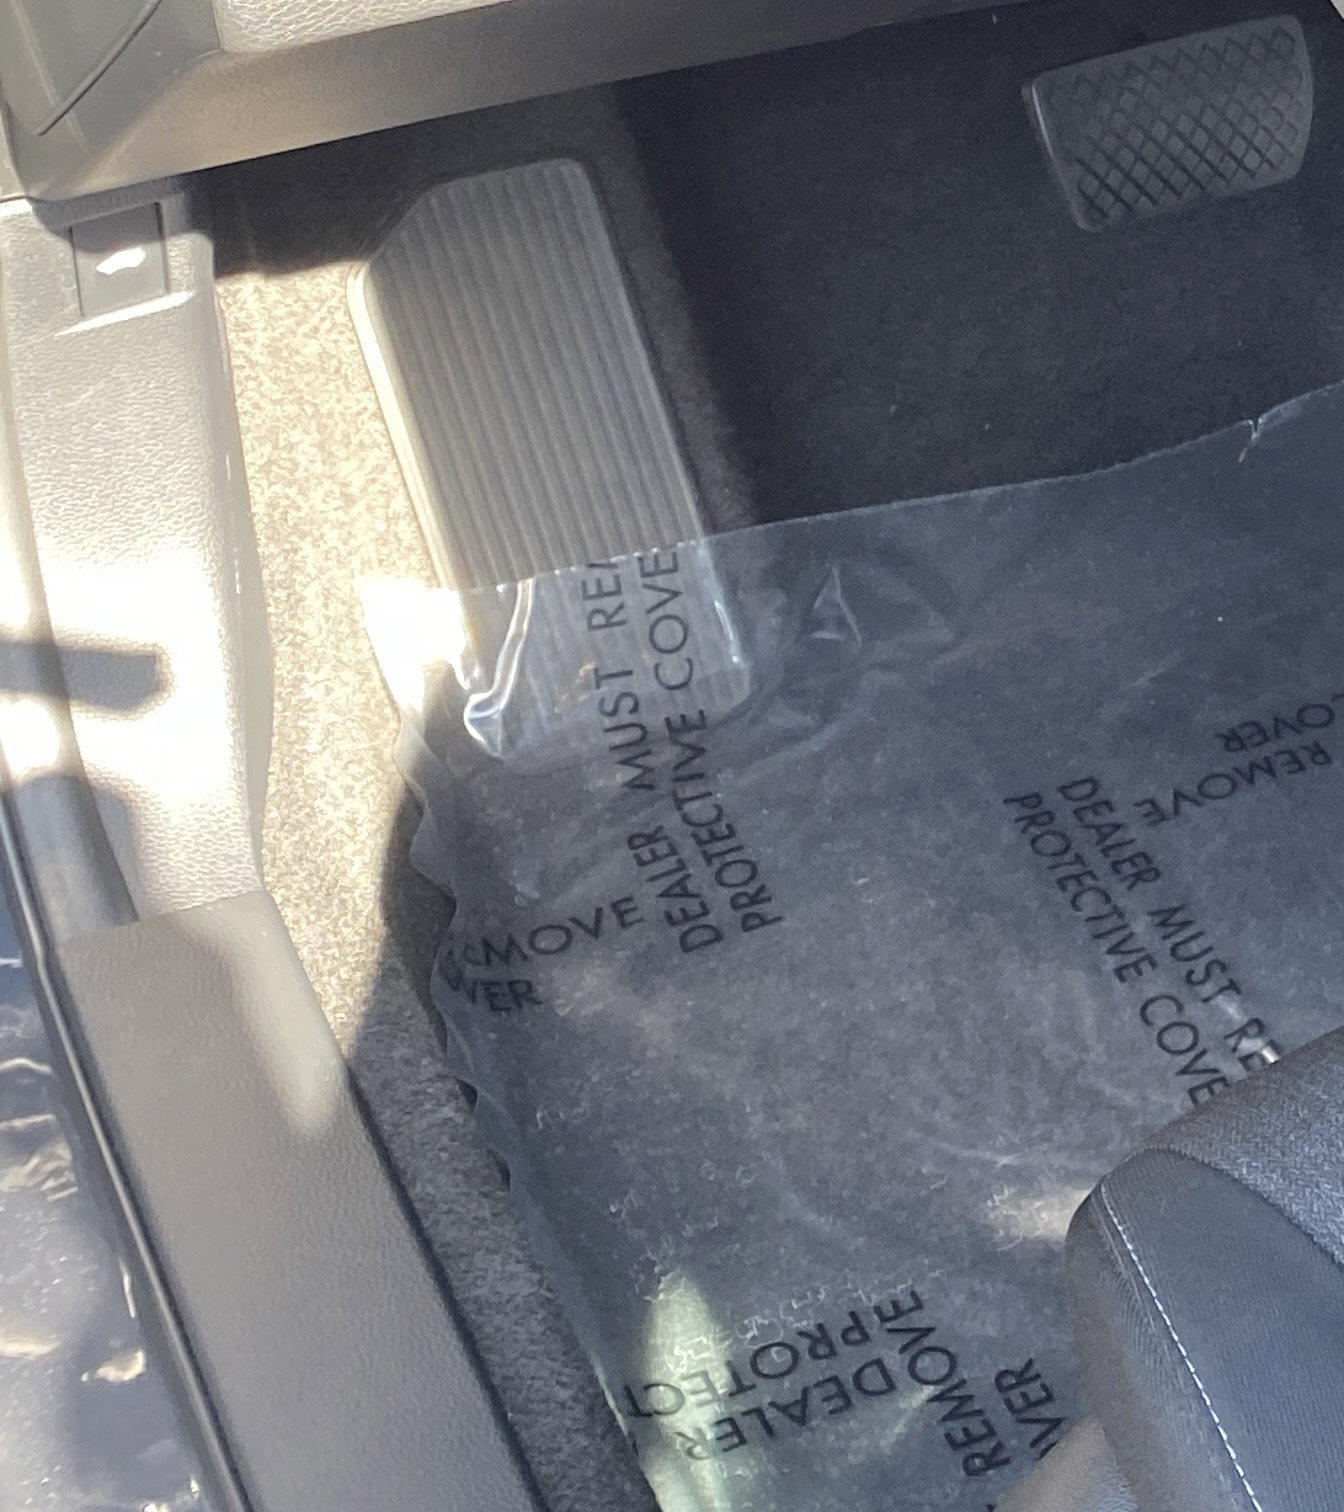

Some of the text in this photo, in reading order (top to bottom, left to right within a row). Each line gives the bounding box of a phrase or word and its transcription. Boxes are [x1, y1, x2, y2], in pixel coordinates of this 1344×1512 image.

[581, 561, 725, 954] DEALER MUST RE
[665, 708, 784, 933] PROTECTIVE
[1133, 741, 1333, 826] REMOVE
[1003, 792, 1158, 984] PROTECTIVE
[1057, 776, 1161, 891] DEALER
[1147, 904, 1242, 1003] MUST
[676, 1357, 895, 1461] DEALER
[873, 1290, 1012, 1477] REMOVE
